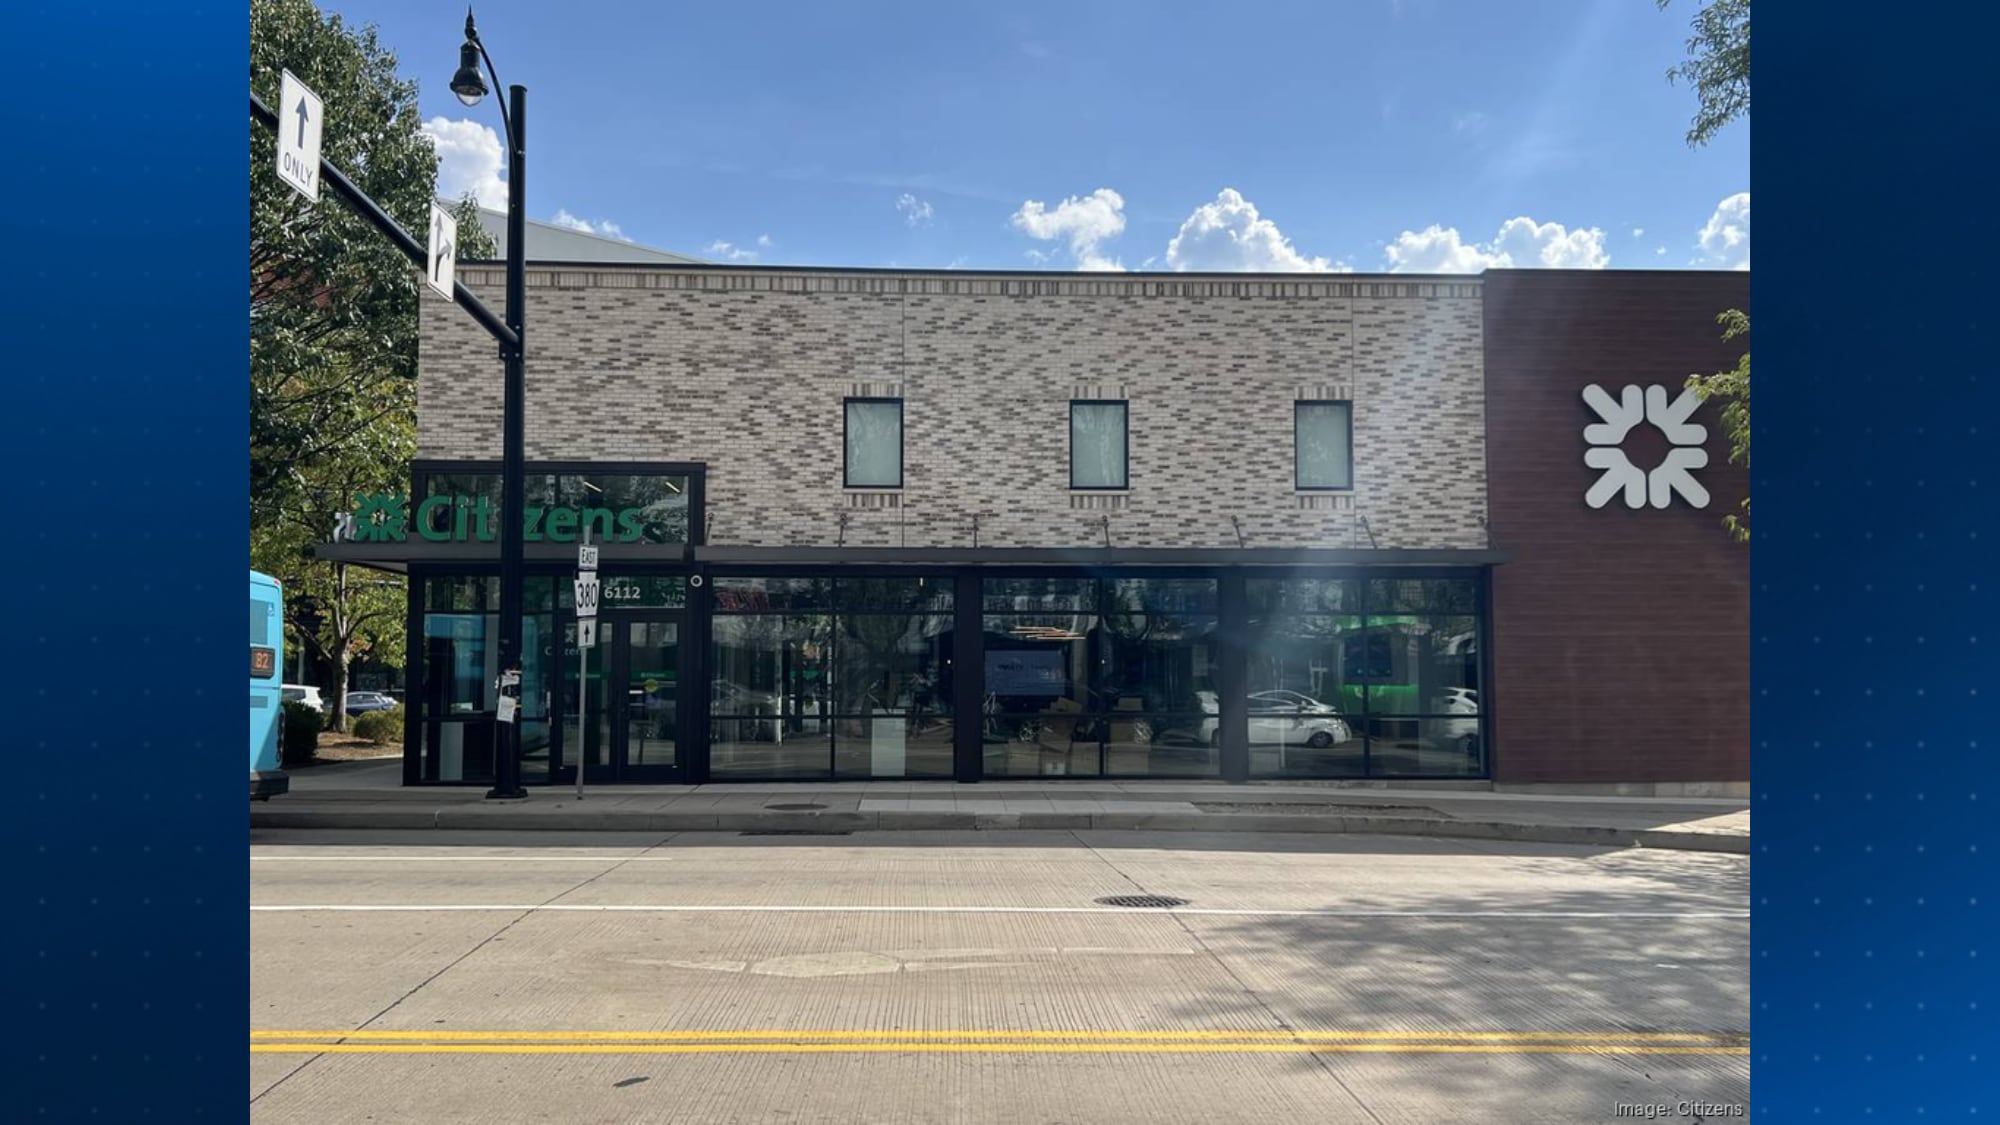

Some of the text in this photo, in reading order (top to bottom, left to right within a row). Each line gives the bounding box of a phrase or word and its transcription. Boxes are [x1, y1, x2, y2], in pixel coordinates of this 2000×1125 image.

[284, 151, 313, 187] ONLY
[416, 495, 643, 542] Citzens
[581, 548, 596, 564] EAST
[577, 583, 598, 608] 380
[604, 586, 641, 599] 6112
[256, 651, 269, 669] 82
